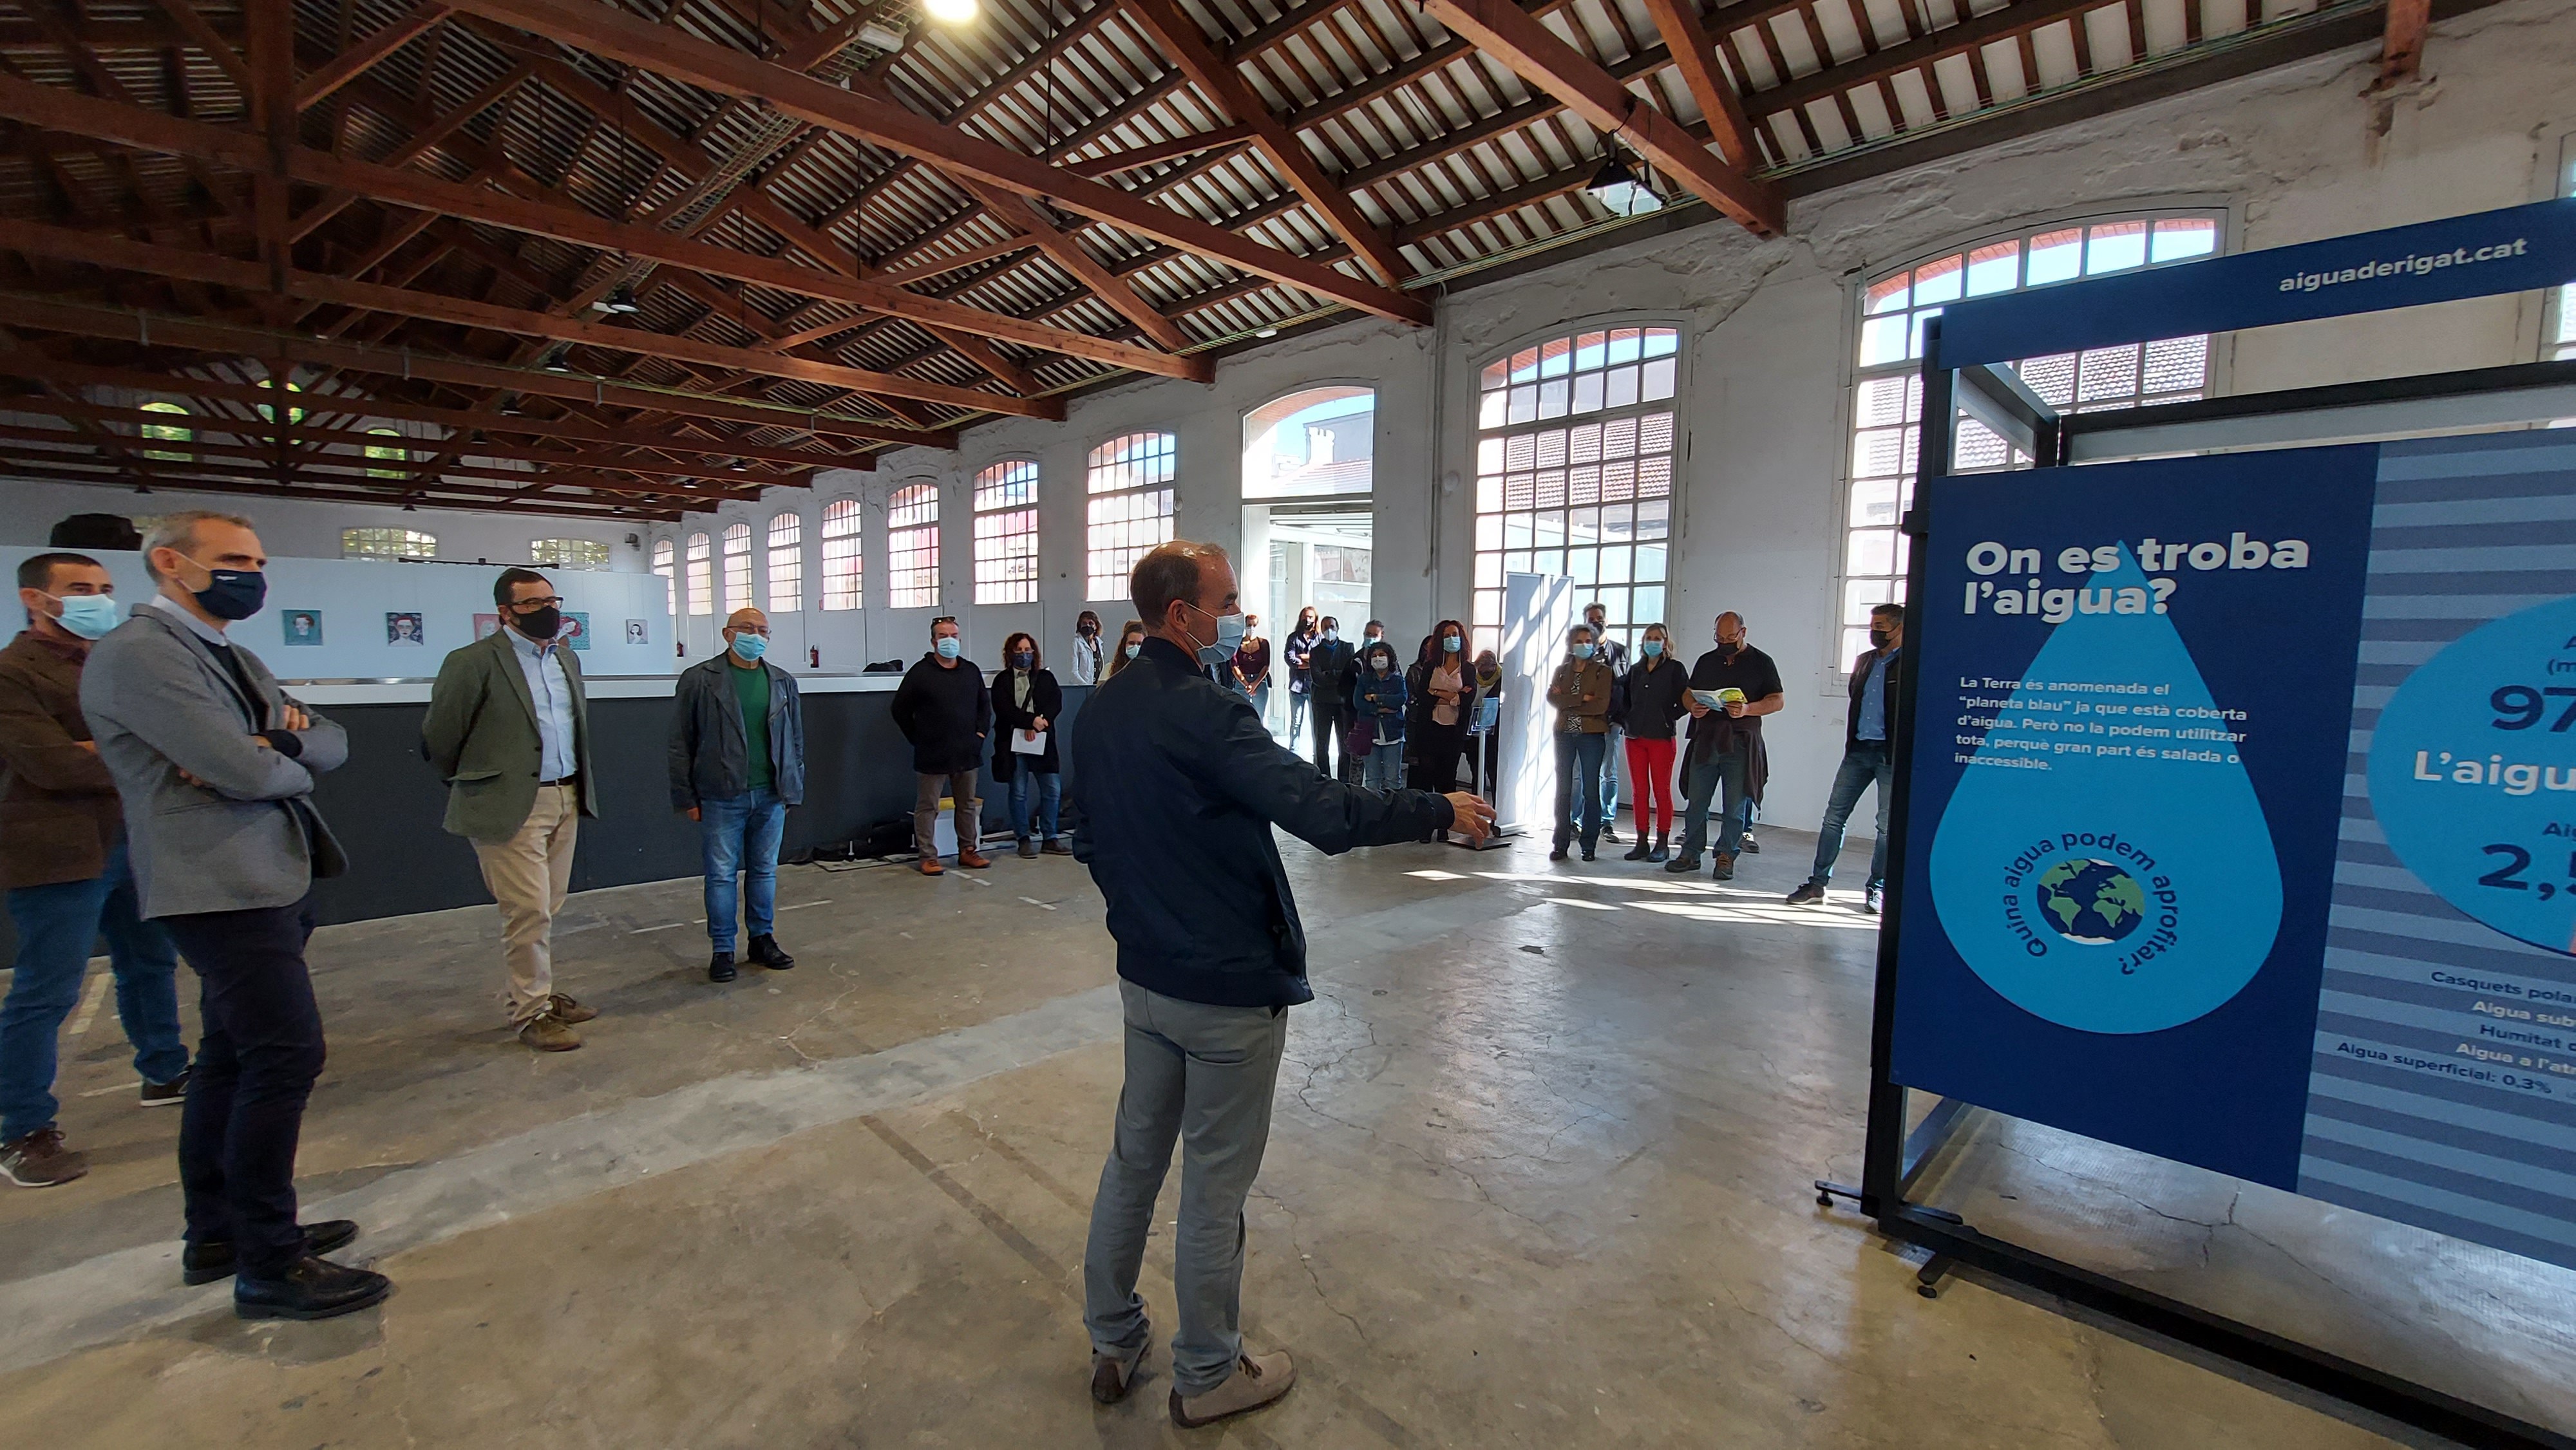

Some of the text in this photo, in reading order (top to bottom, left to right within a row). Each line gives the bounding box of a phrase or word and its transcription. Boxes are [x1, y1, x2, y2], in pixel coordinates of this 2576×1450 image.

[2278, 238, 2528, 292] aiguaderigat.cat
[1966, 532, 2309, 575] On es troba
[1960, 677, 2170, 695] La Terra és anomenada el
[2073, 701, 2090, 715] ja
[2095, 704, 2128, 717] que
[2132, 706, 2170, 717] està
[2175, 707, 2248, 720] coberta
[2022, 718, 2060, 731] Però
[2063, 722, 2085, 733] no
[2089, 722, 2105, 734] la
[2108, 725, 2170, 740] podem
[2175, 728, 2248, 743] utilitzar
[1954, 752, 2053, 771] inaccessible.
[1956, 734, 2240, 764] tota, perquè gran part és salada o
[2002, 833, 2179, 975] Quina aigua podem aprofitar?
[2431, 971, 2522, 995] Casquets
[2472, 1001, 2531, 1021] Aigua
[2480, 1024, 2561, 1049] Humitat
[2337, 1042, 2389, 1061] Aigua
[2393, 1053, 2496, 1082] superficial:
[2455, 1042, 2514, 1064] Aigua
[2519, 1057, 2532, 1066] a
